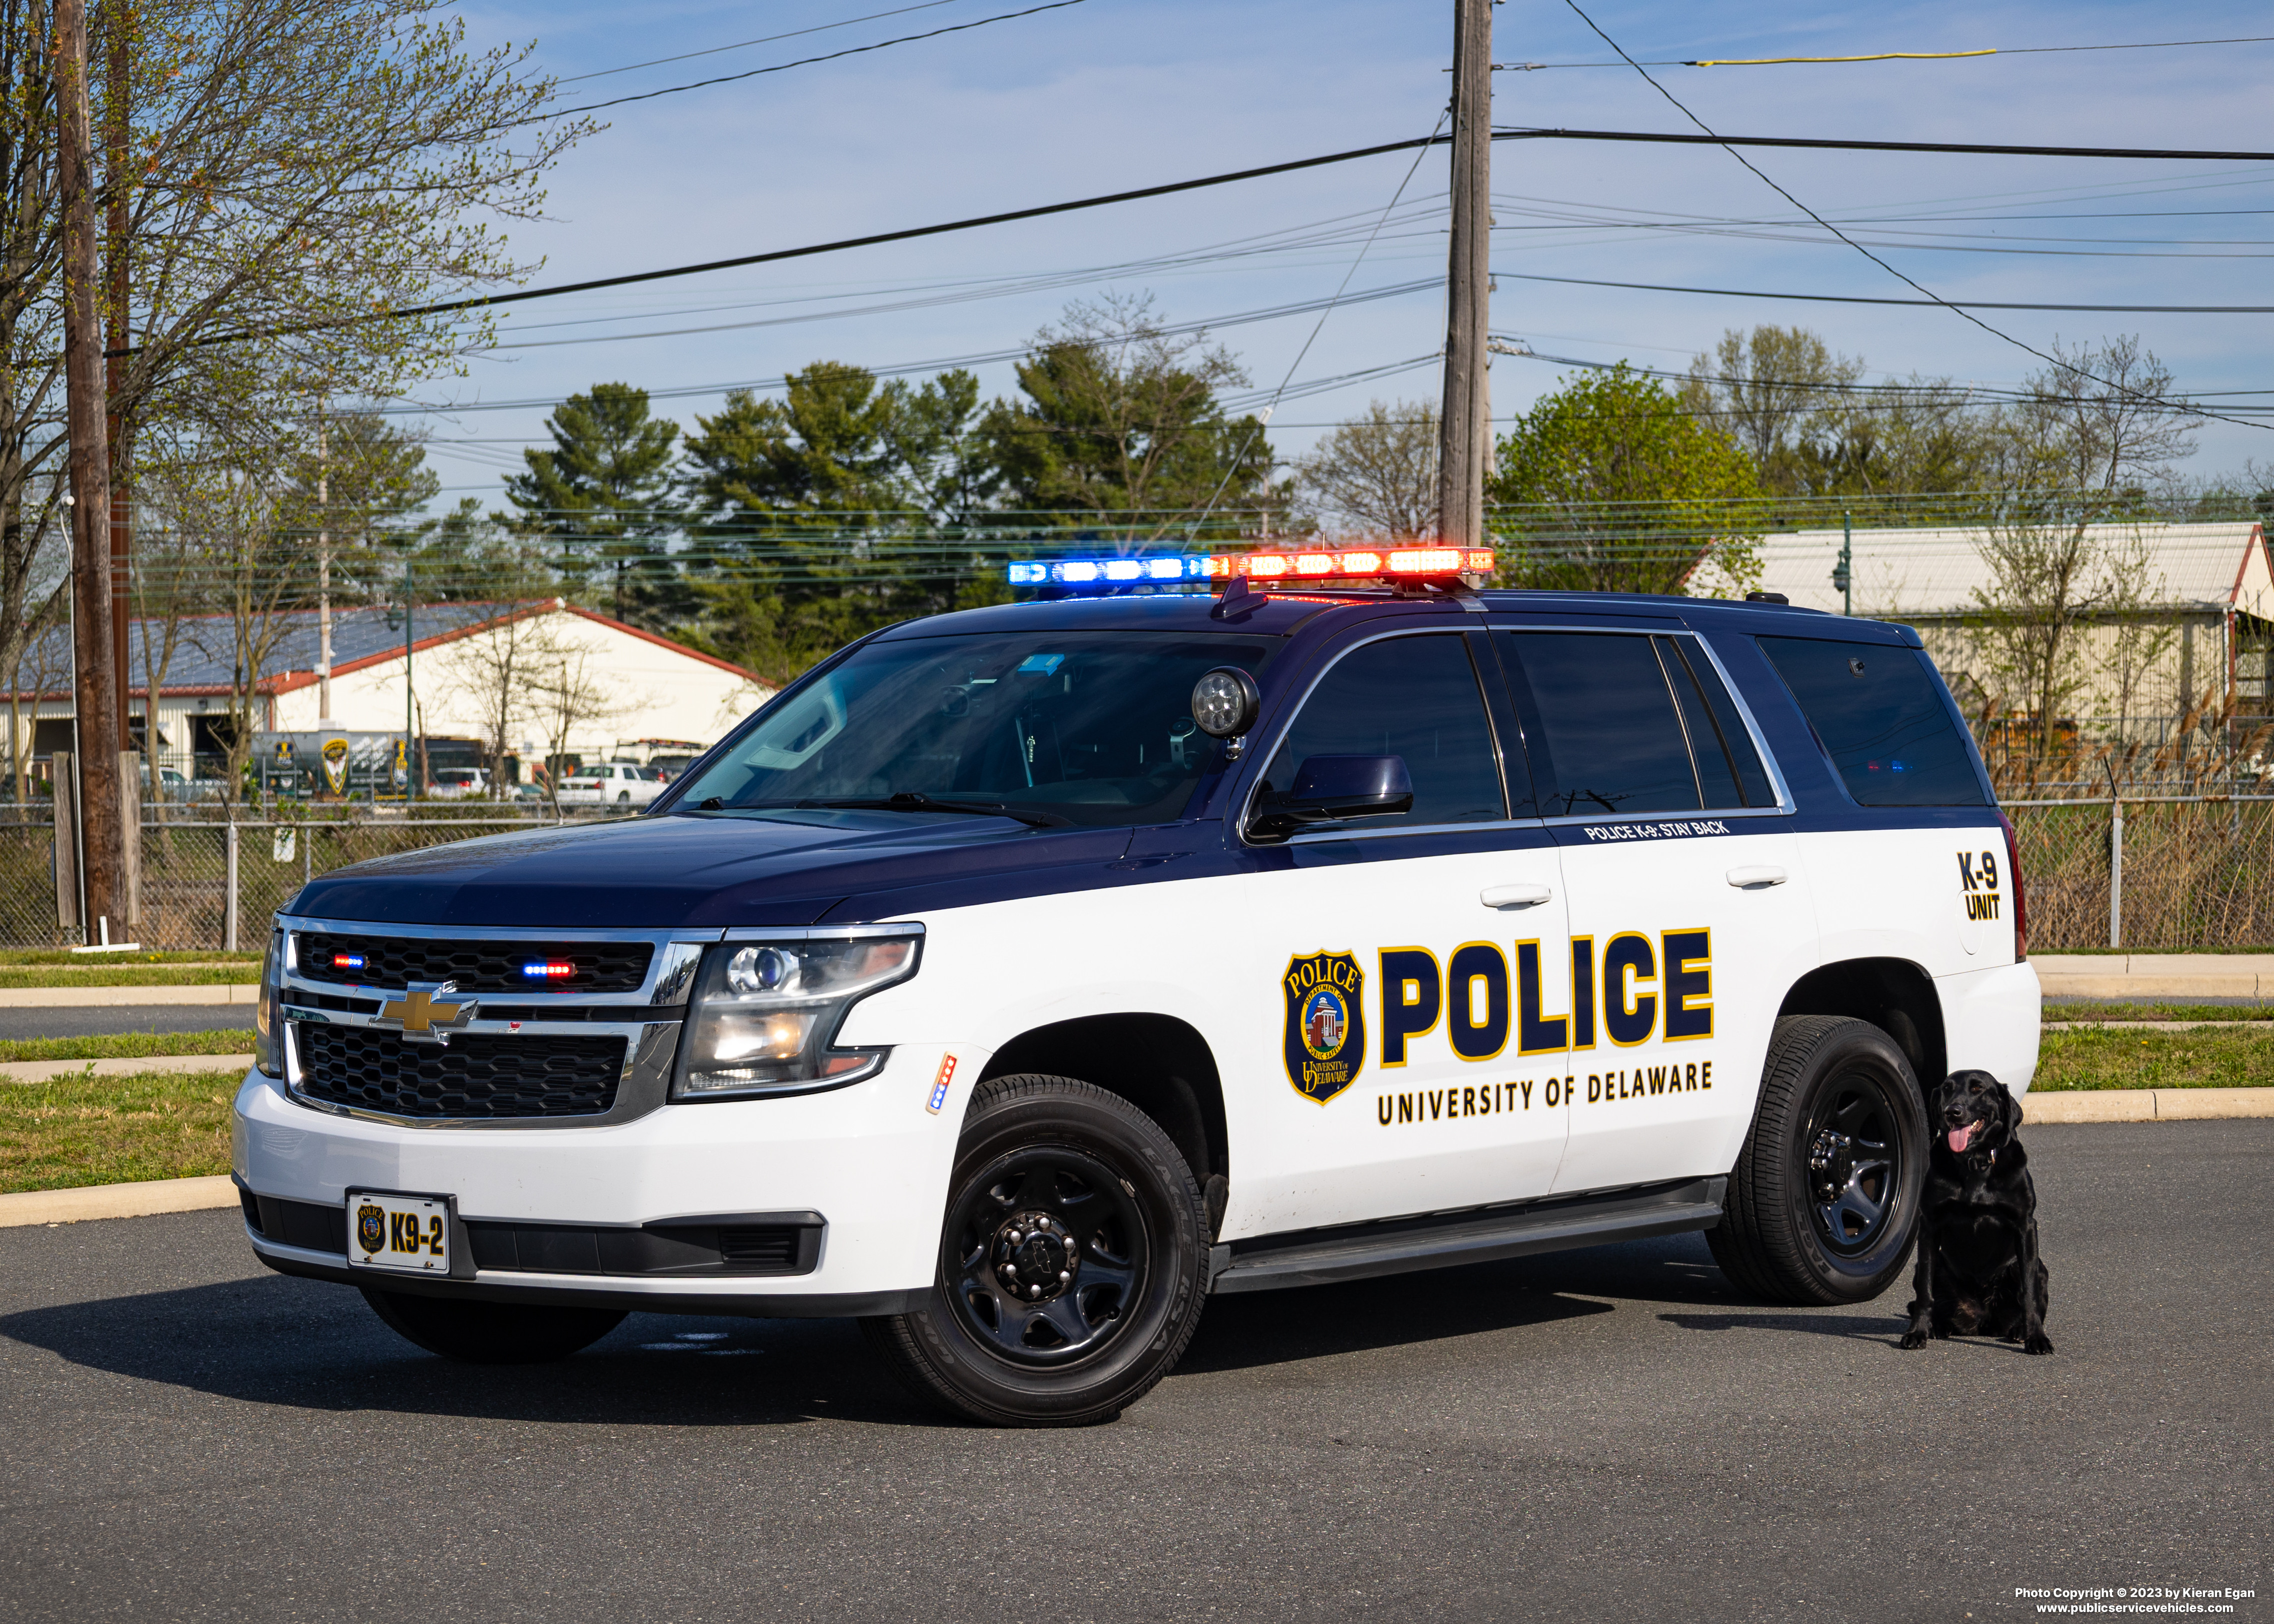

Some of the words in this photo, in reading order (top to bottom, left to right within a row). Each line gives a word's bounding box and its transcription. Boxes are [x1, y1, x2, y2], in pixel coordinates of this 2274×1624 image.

[1584, 826, 1637, 840] POLICE
[1633, 824, 1662, 838] K-9:
[1659, 822, 1693, 837] STAY
[1690, 821, 1730, 835] BACK
[1957, 851, 1998, 890] K-9
[1965, 893, 2000, 921] UNIT
[1287, 958, 1358, 999] POLICE
[1305, 984, 1337, 1006] DEPARTMENT
[1337, 993, 1344, 1002] OF
[1377, 926, 1715, 1070] POLICE
[1308, 1045, 1324, 1059] PUBLIC
[1325, 1043, 1342, 1059] SAFETY
[1302, 1061, 1343, 1082] UNIVERSITY
[1304, 1070, 1348, 1093] DELAWARE
[1377, 1079, 1534, 1127] UNIVERSITY
[1545, 1075, 1575, 1109] OF
[1588, 1060, 1712, 1104] DELAWARE
[359, 1207, 384, 1220] POLICE
[390, 1211, 444, 1257] K9-2
